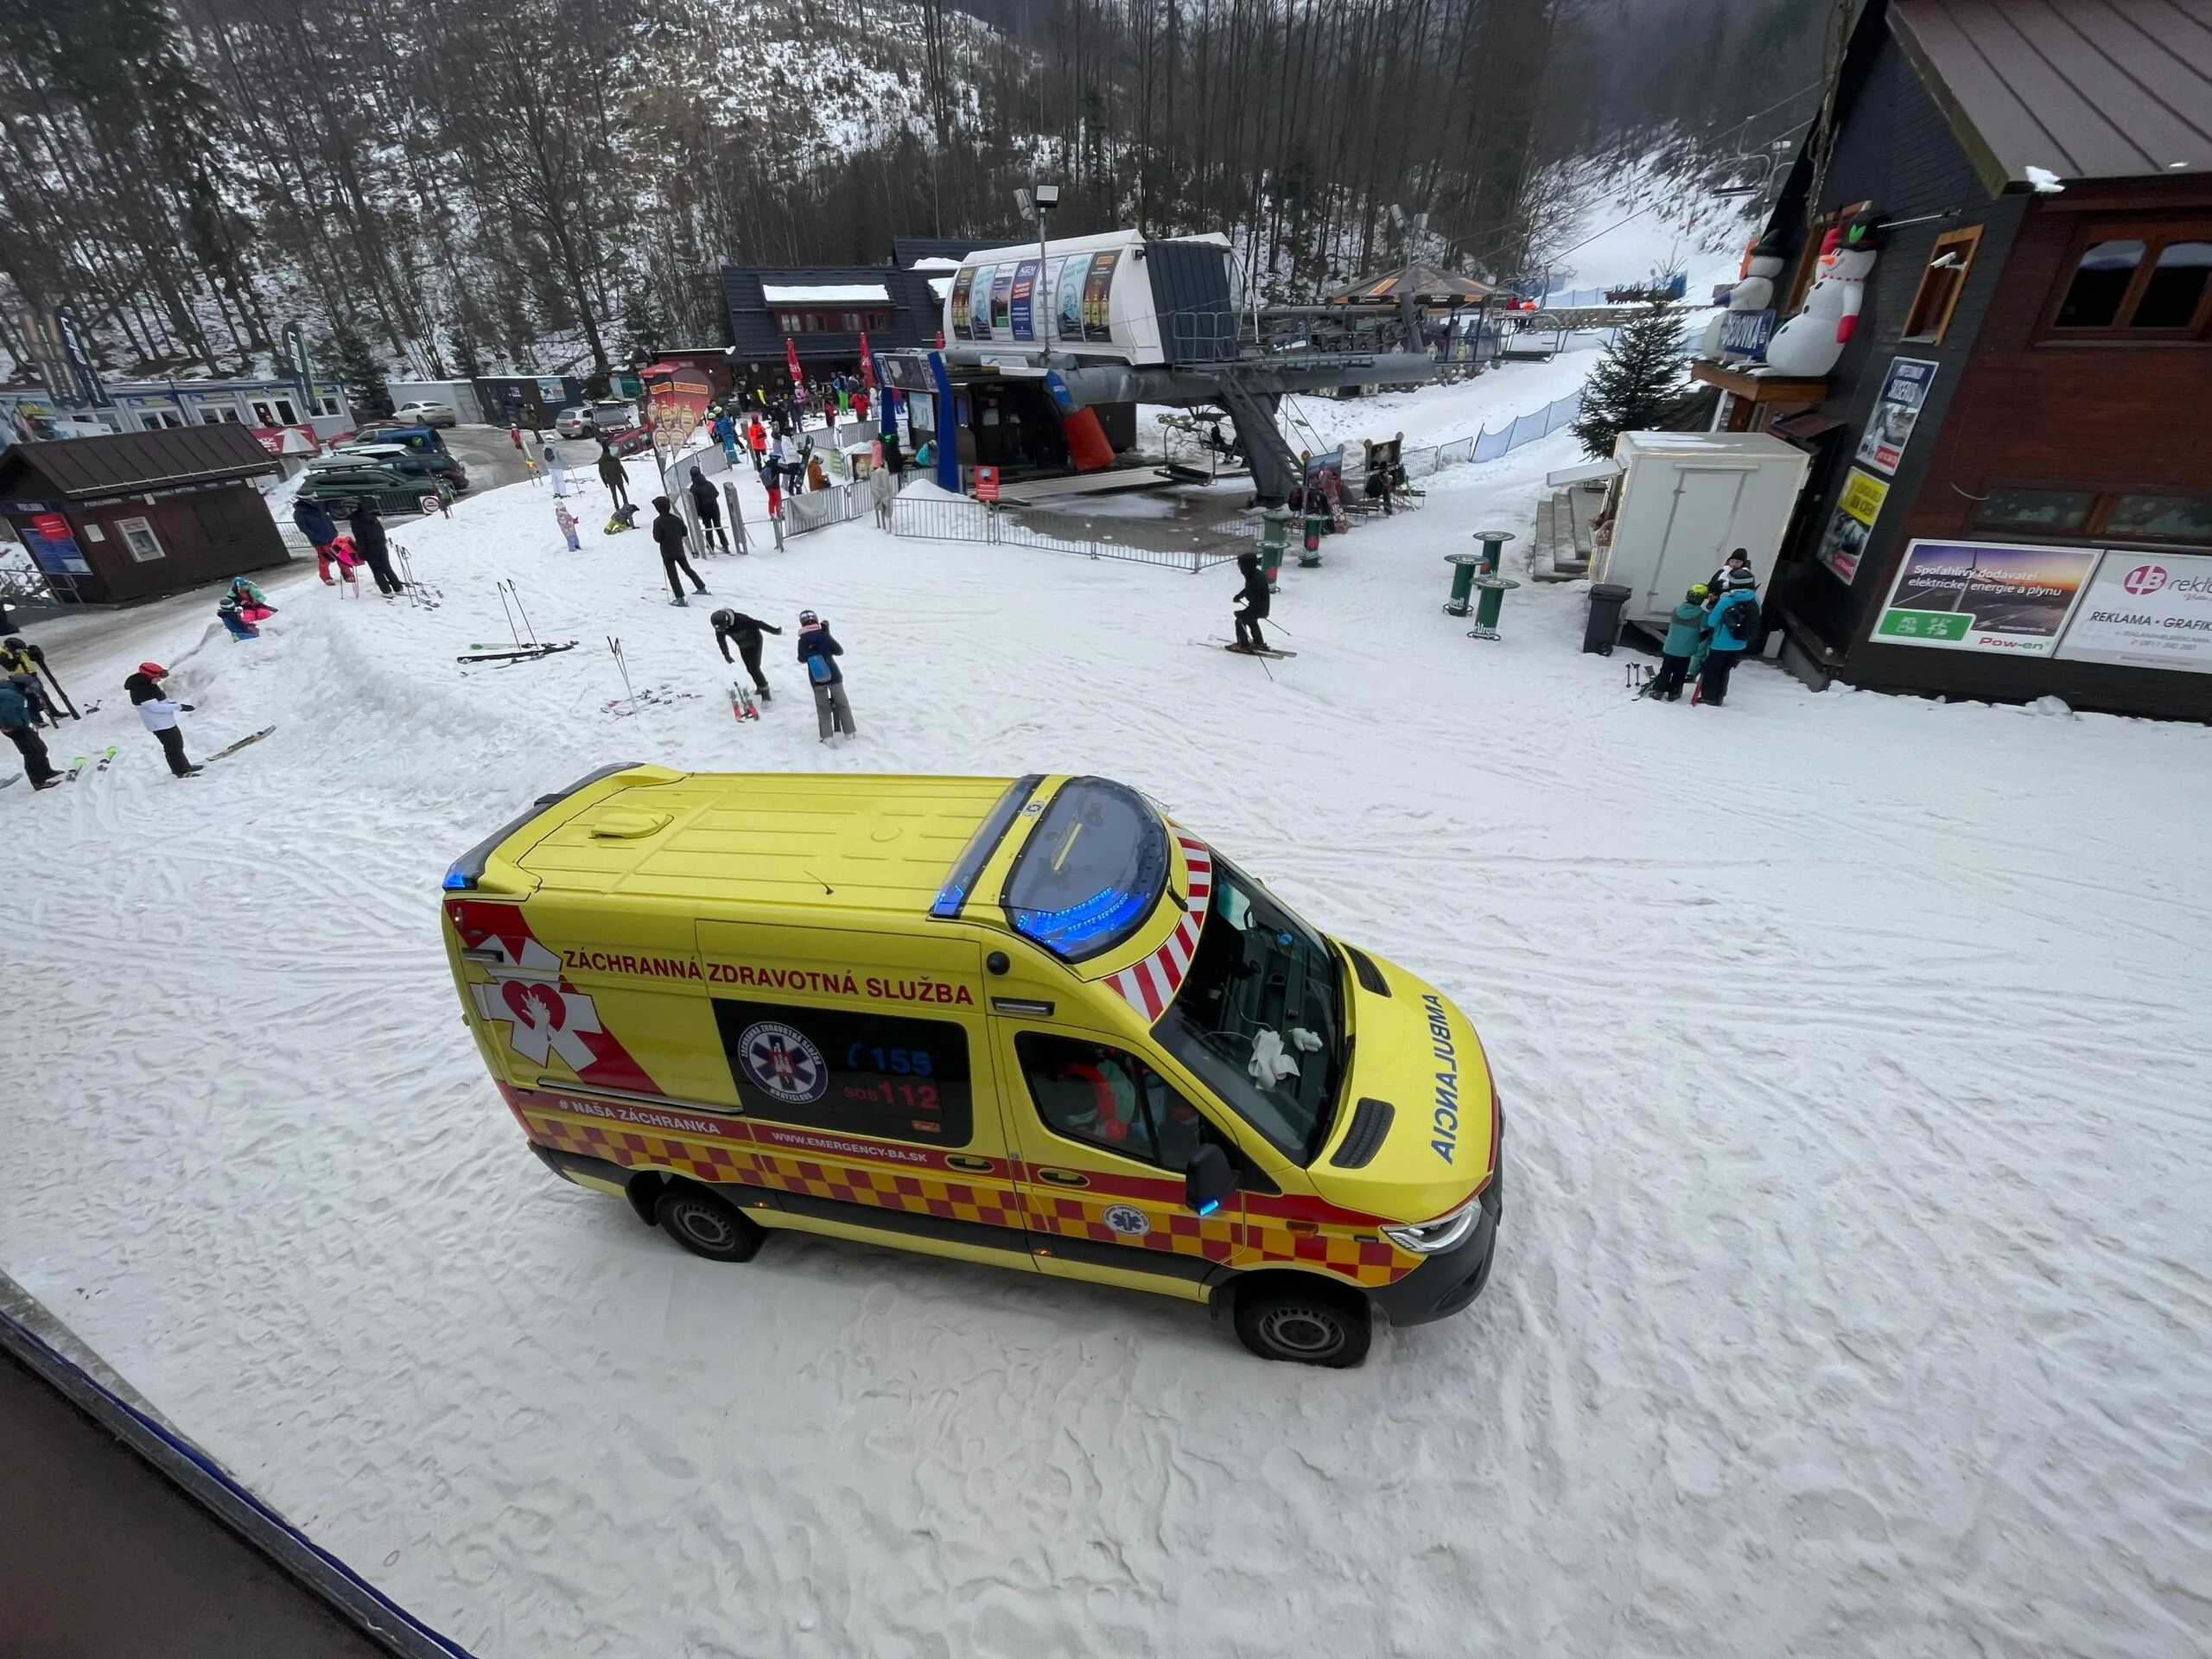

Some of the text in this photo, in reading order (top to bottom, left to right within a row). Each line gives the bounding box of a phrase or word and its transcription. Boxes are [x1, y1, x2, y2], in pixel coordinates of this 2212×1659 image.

[1908, 577, 1970, 592] elektrickej
[1970, 582, 2015, 594] energie
[2026, 585, 2063, 597] plynu
[2089, 611, 2212, 632] REKLAMA GRAFIK
[1979, 637, 2044, 650] Pow-en
[563, 946, 974, 1006] ZÁCHRANNÁ ZDRAVOTNÁ SLUŽBA
[871, 1046, 933, 1077] 155
[879, 1080, 940, 1110] 112
[572, 1101, 617, 1119] NAŠA
[617, 1107, 721, 1135] ZÁCHRANKA
[771, 1132, 928, 1162] WWW.EMERGENCY-BA.SK
